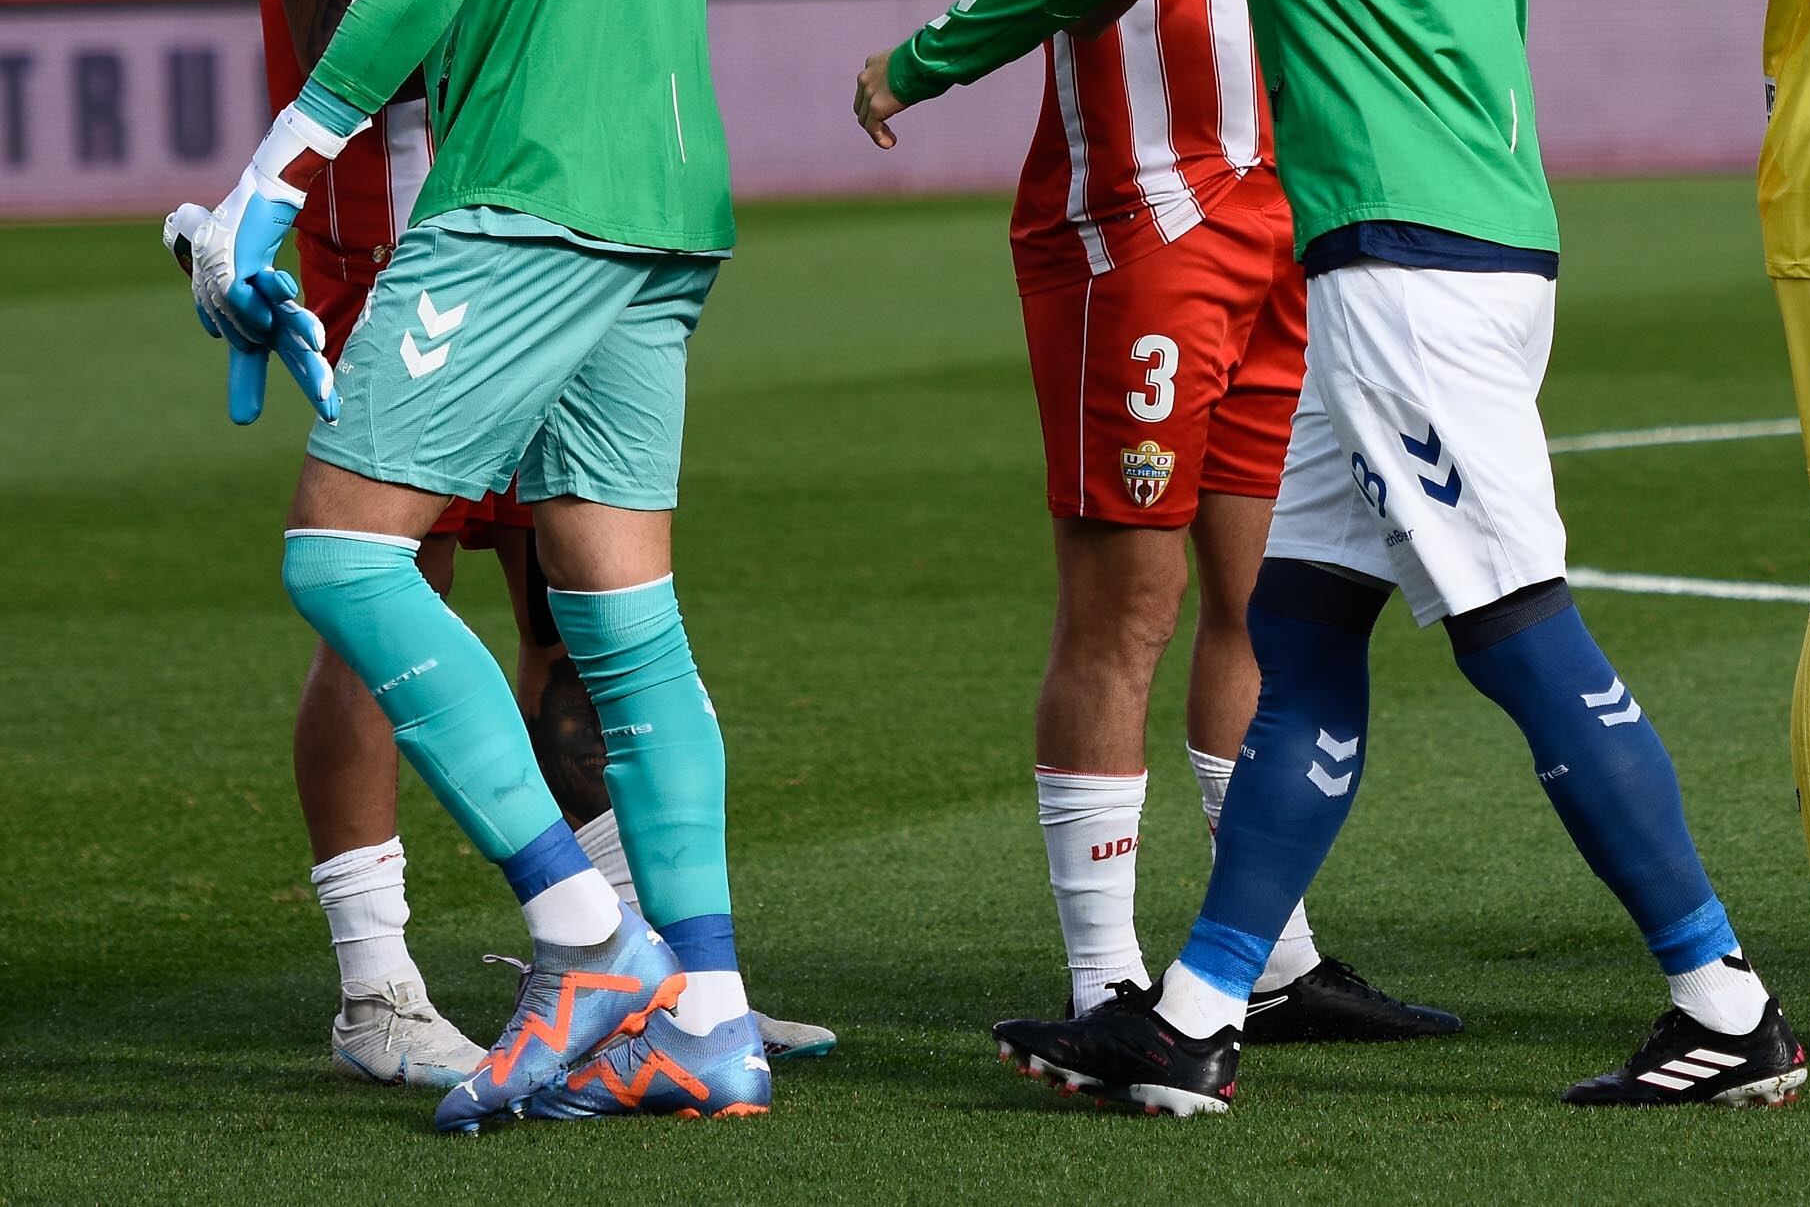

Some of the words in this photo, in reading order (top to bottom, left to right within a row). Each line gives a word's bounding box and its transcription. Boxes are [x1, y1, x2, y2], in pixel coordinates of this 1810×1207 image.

[0, 50, 268, 164] TRU
[1126, 334, 1179, 423] 3
[1127, 454, 1138, 464] U
[1157, 456, 1168, 466] D
